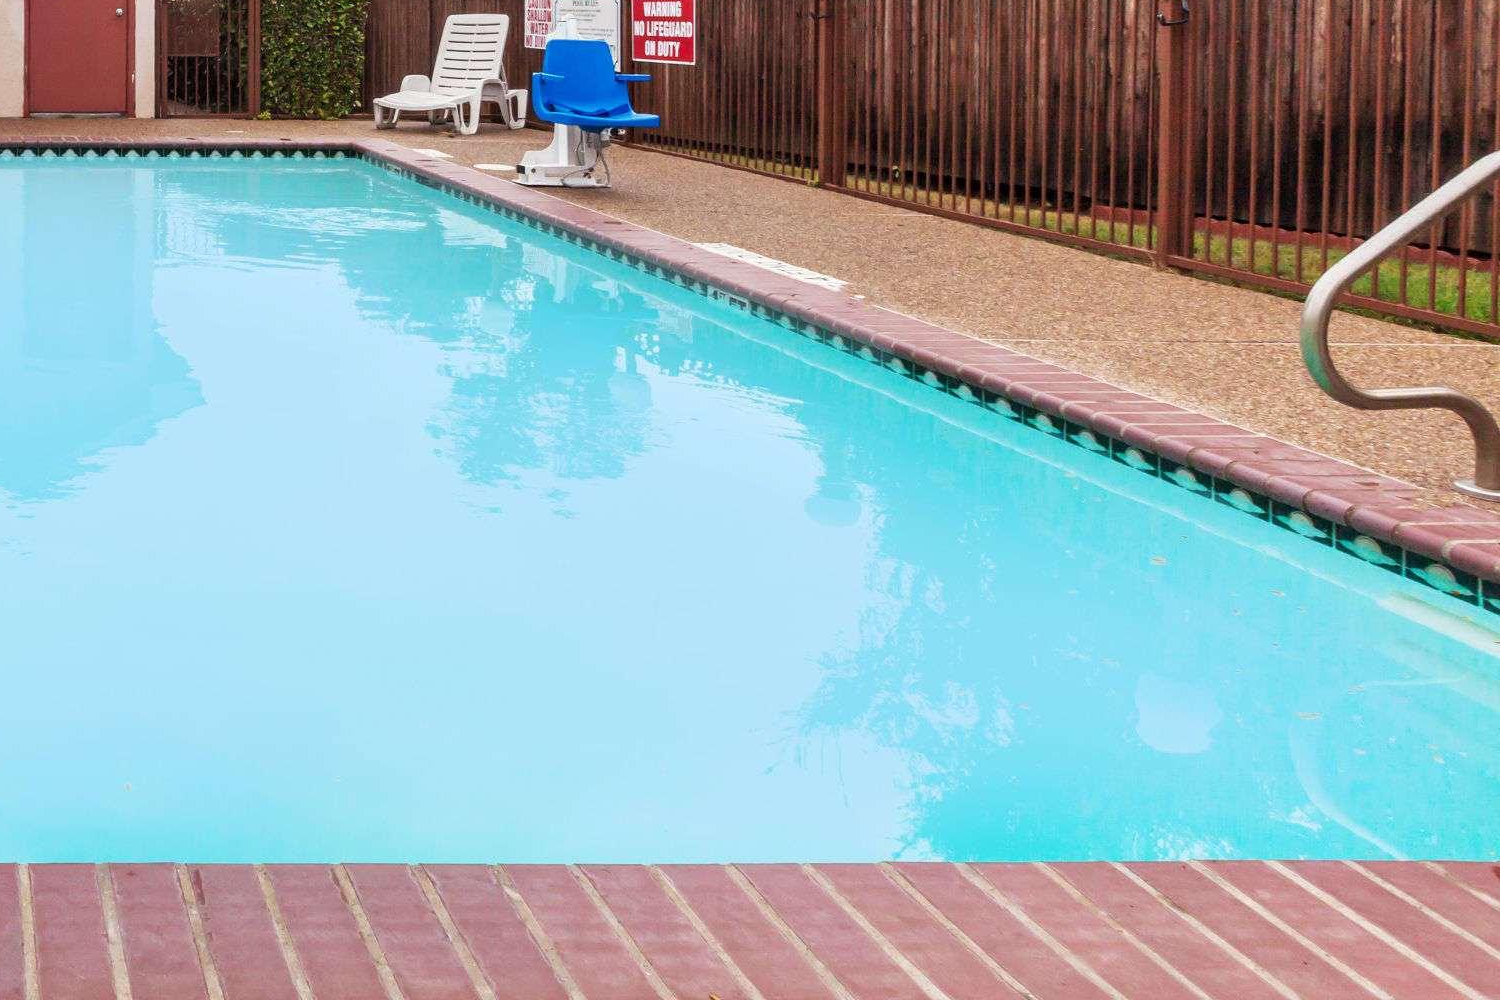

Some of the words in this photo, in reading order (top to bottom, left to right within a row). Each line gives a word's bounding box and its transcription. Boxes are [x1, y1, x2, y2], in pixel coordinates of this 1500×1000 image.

[643, 1, 682, 17] WARNING
[530, 22, 549, 35] WATER
[634, 21, 644, 36] NO
[647, 21, 693, 37] LIFEGUARD
[645, 40, 656, 56] ON
[657, 41, 681, 57] DUTY
